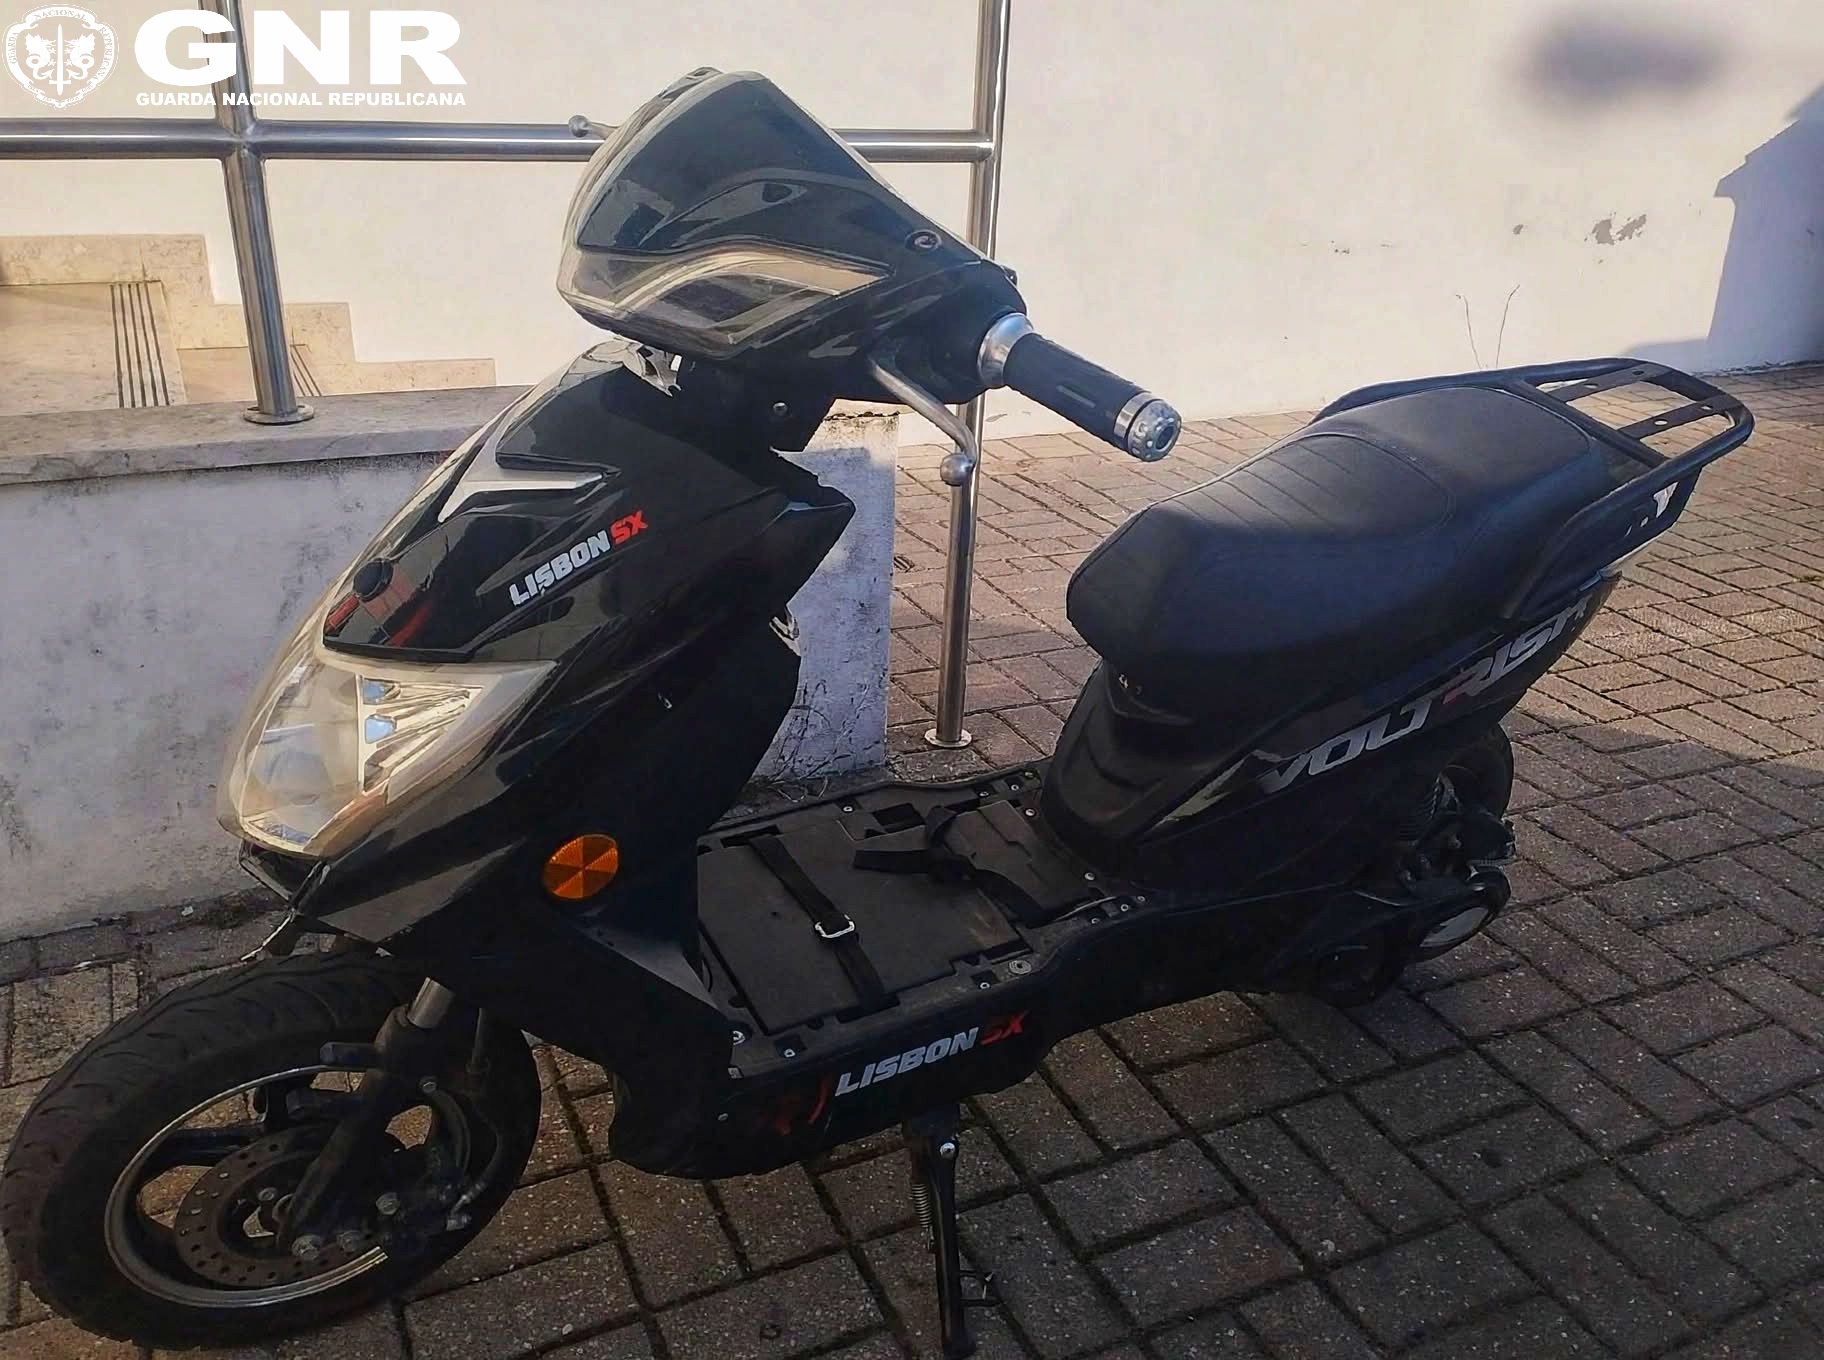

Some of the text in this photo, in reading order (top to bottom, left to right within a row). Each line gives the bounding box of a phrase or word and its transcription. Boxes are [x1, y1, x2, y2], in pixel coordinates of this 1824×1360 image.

[509, 510, 648, 606] LISBON SX
[834, 1027, 978, 1096] LISBON
